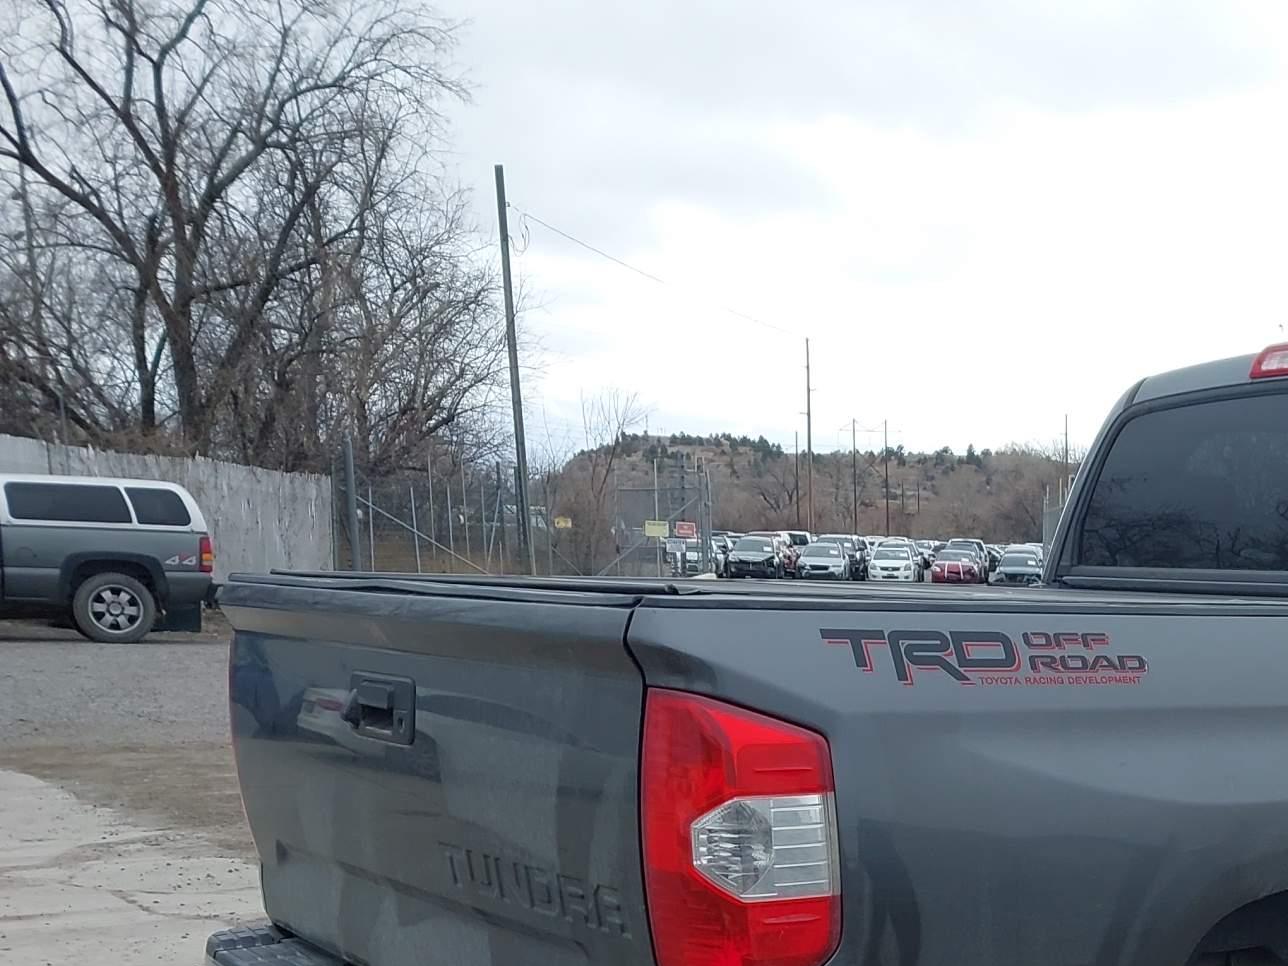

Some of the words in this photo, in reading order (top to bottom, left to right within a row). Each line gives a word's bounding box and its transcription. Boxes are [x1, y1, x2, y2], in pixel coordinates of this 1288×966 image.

[1022, 631, 1109, 650] OFF
[819, 628, 1022, 686] TRD
[1029, 654, 1149, 674] ROAD
[978, 676, 1022, 686] TOYOTA
[1024, 676, 1065, 686] RACING
[1067, 676, 1143, 686] DEVELOPMENT
[438, 841, 634, 940] TUNDRA
